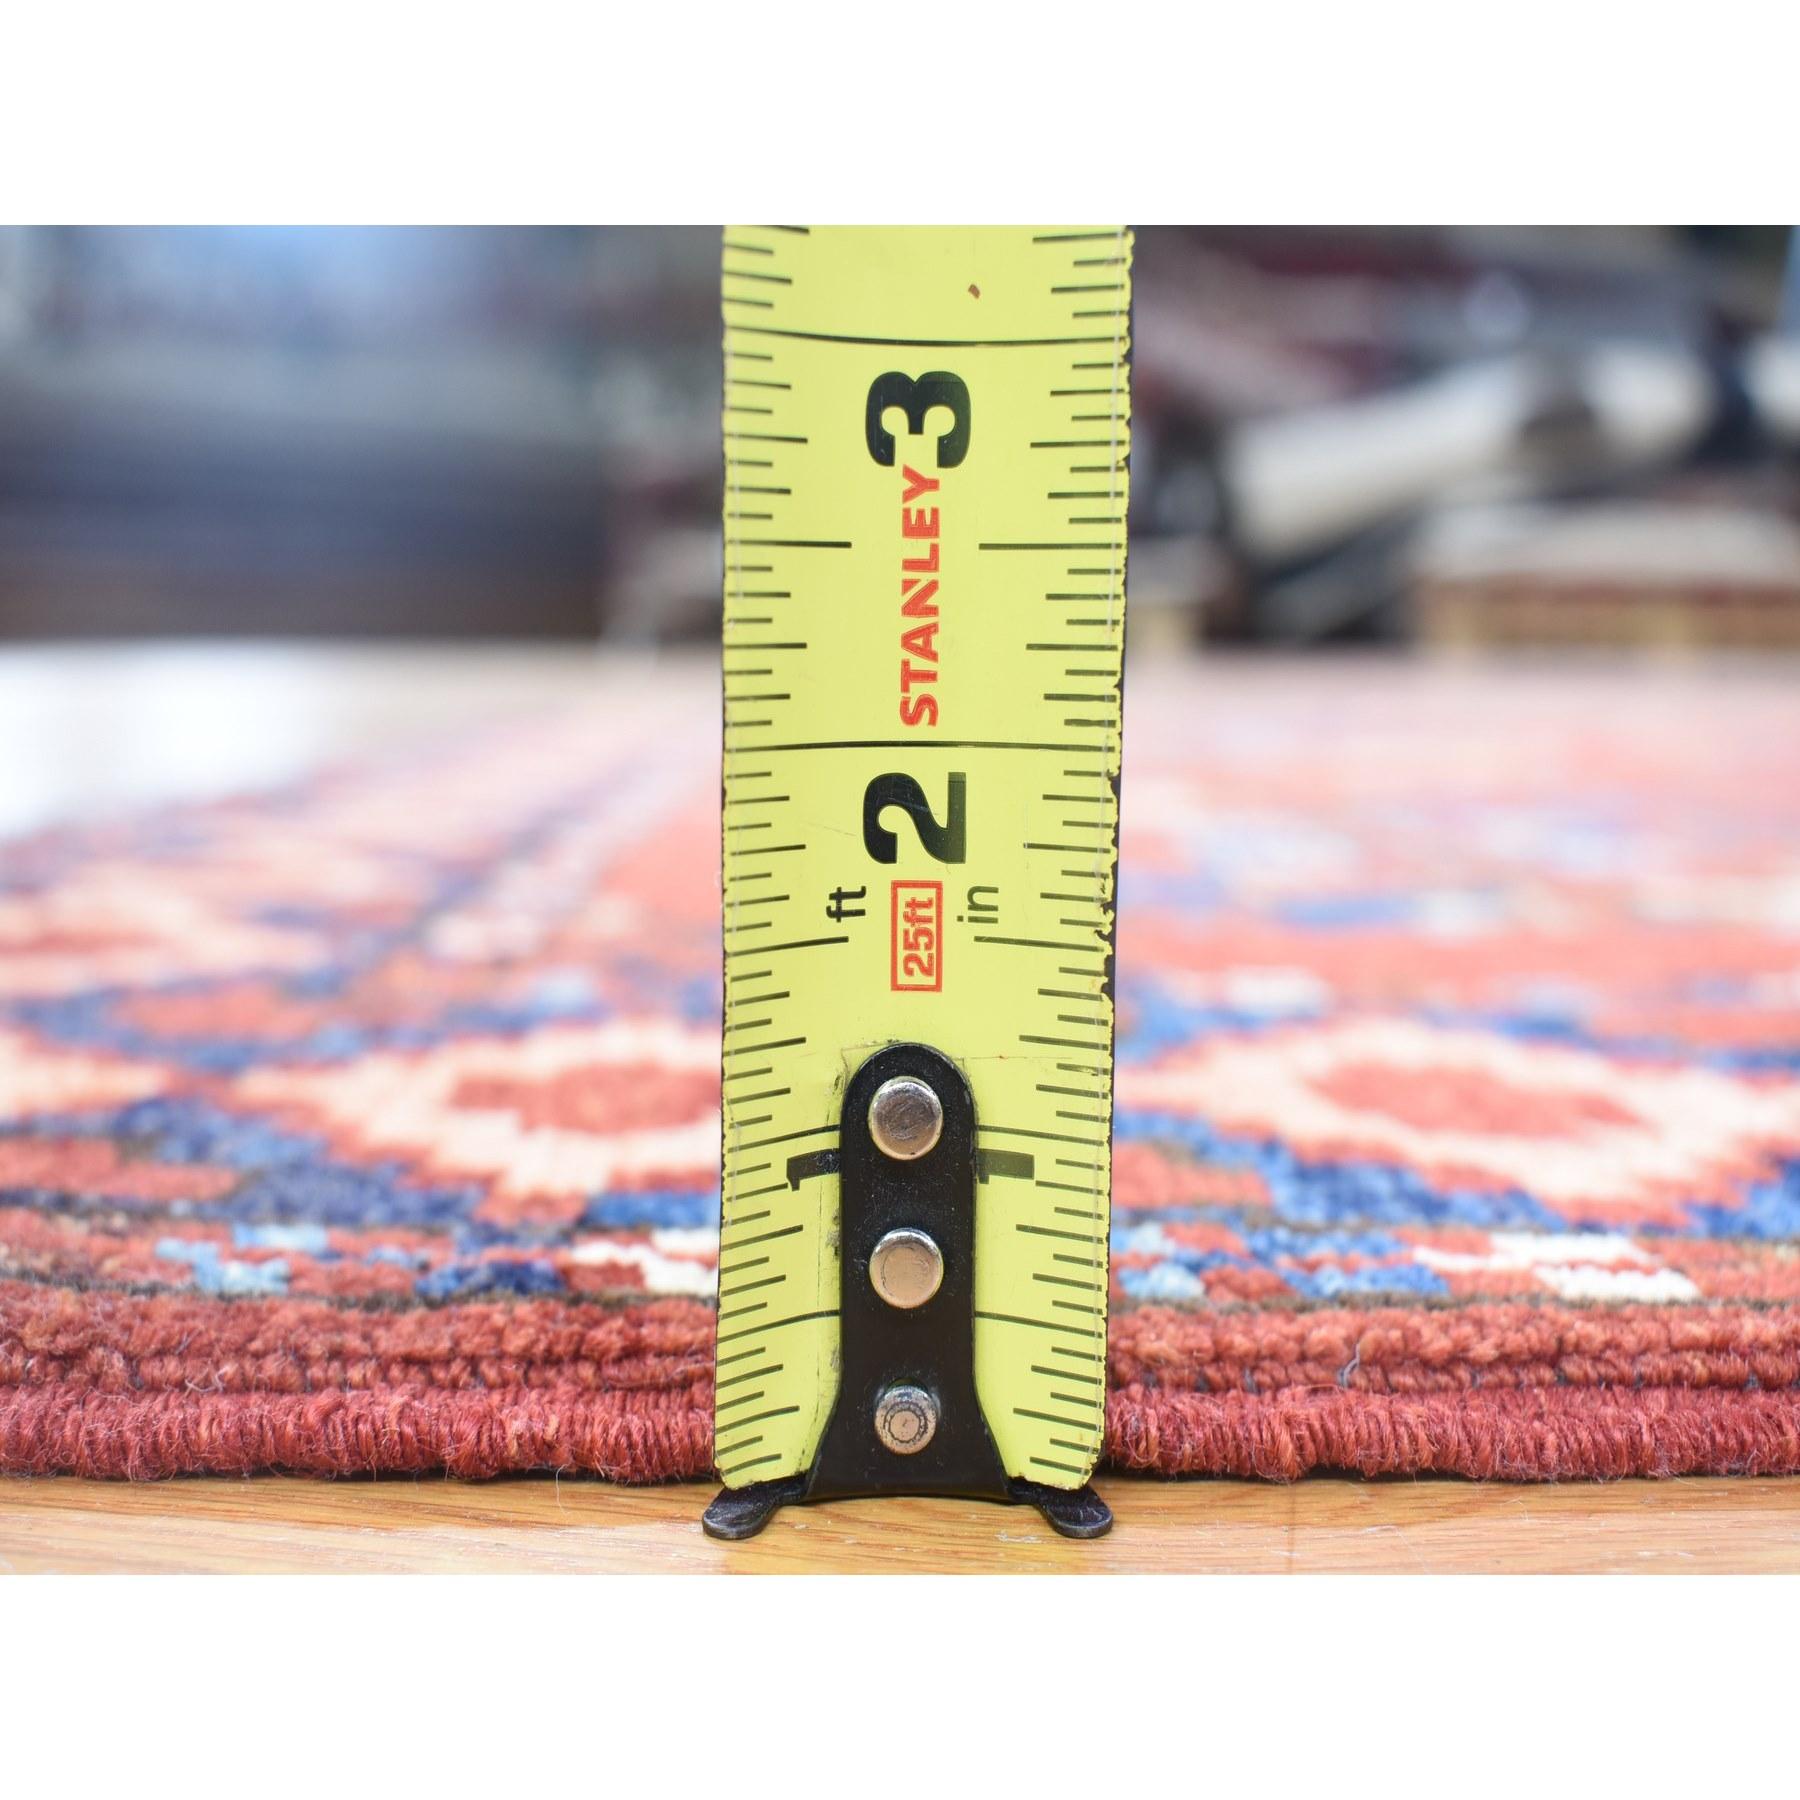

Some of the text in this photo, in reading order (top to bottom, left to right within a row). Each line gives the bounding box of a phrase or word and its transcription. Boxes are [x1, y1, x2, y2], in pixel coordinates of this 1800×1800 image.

[865, 371, 971, 469] 3
[899, 464, 940, 728] STANLEY
[863, 771, 967, 865] 2
[826, 885, 867, 923] ft
[902, 896, 936, 978] 25ft
[956, 885, 999, 924] in
